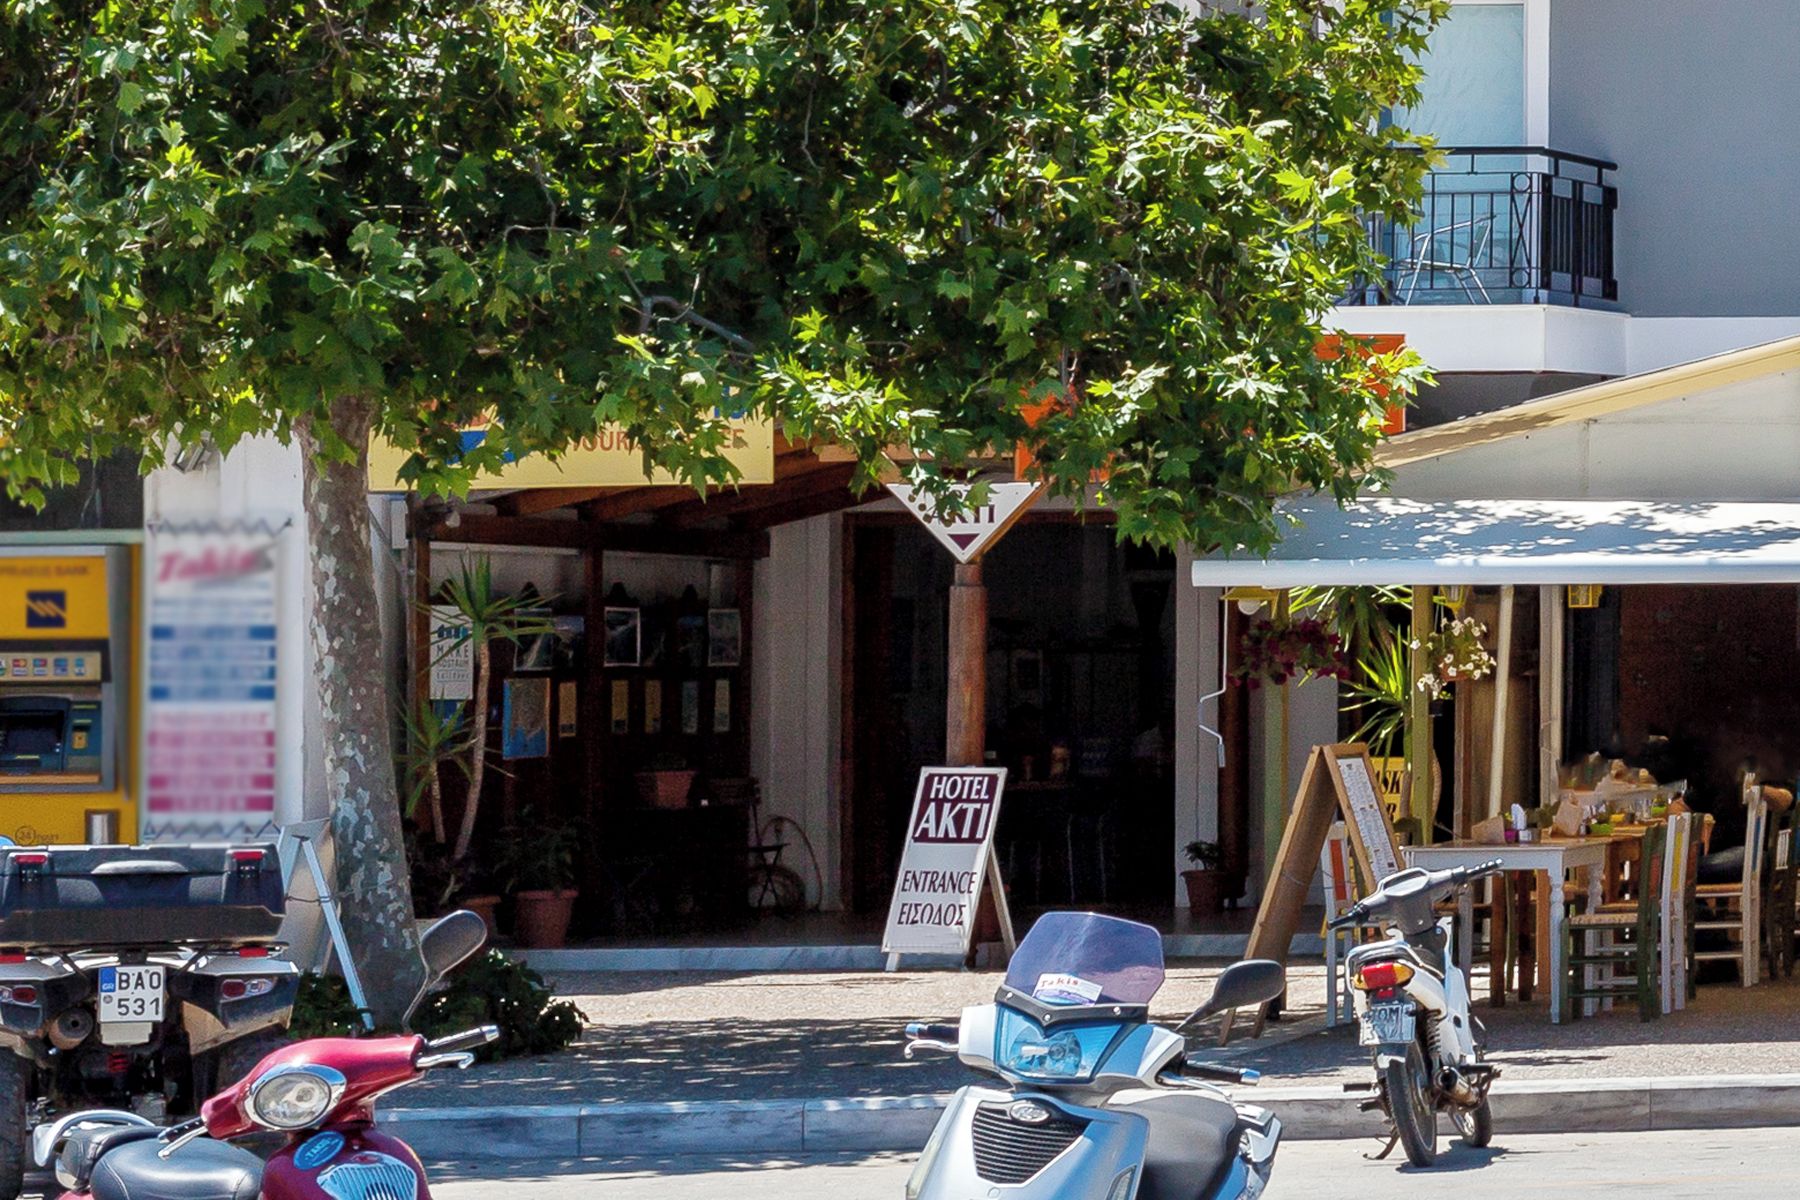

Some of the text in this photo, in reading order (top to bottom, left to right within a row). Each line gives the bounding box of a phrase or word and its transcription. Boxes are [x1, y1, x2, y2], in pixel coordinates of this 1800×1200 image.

[930, 775, 990, 800] HOTEL
[914, 802, 990, 839] AKTI
[901, 870, 977, 895] ENTRANCE
[897, 903, 966, 927] ΕΙΣΟΔΟΣ
[117, 997, 161, 1016] 531
